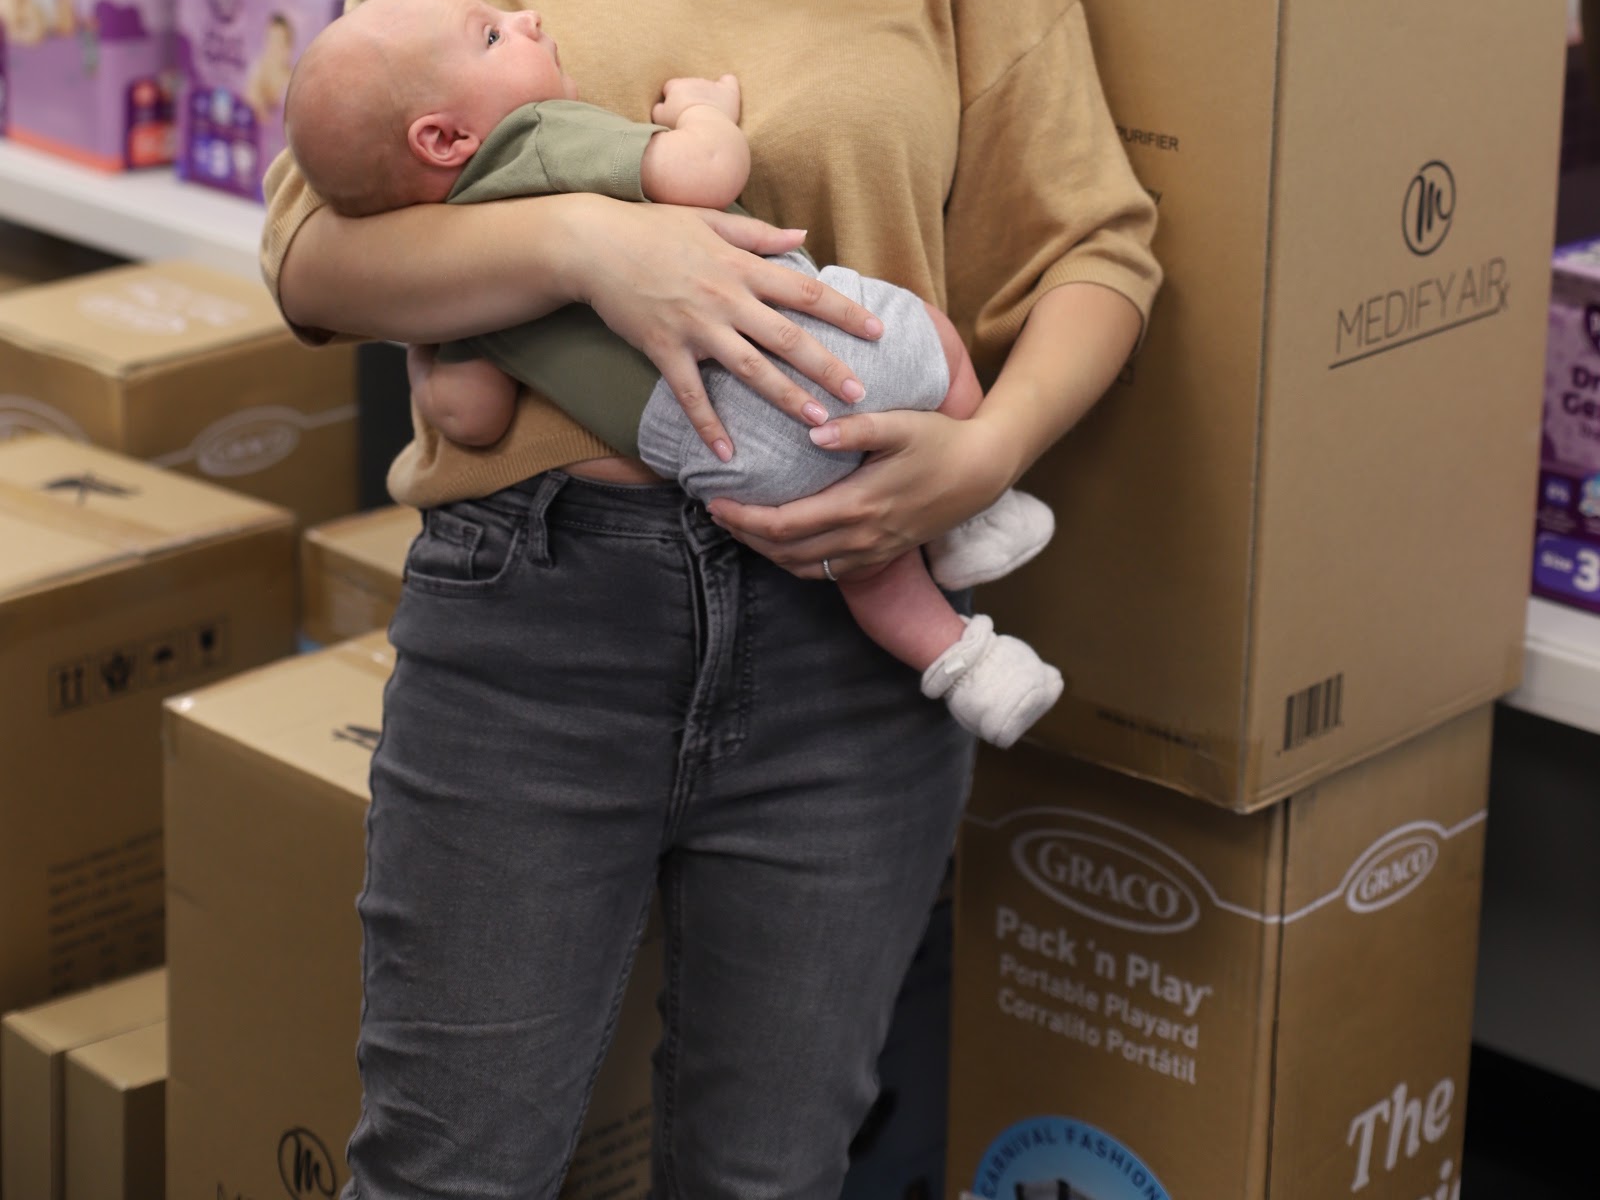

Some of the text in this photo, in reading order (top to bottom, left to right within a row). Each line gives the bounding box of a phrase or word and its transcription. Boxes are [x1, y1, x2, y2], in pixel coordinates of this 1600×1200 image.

[1336, 272, 1456, 355] MEDIFY
[1037, 840, 1180, 920] GRACO
[1359, 847, 1429, 902] GRACO
[996, 904, 1077, 967] Pack
[998, 987, 1196, 1086] Corralito Portátil
[1000, 953, 1199, 1050] Portable Playard
[980, 1126, 1058, 1200] CARNIVAL
[1347, 1077, 1455, 1193] The
